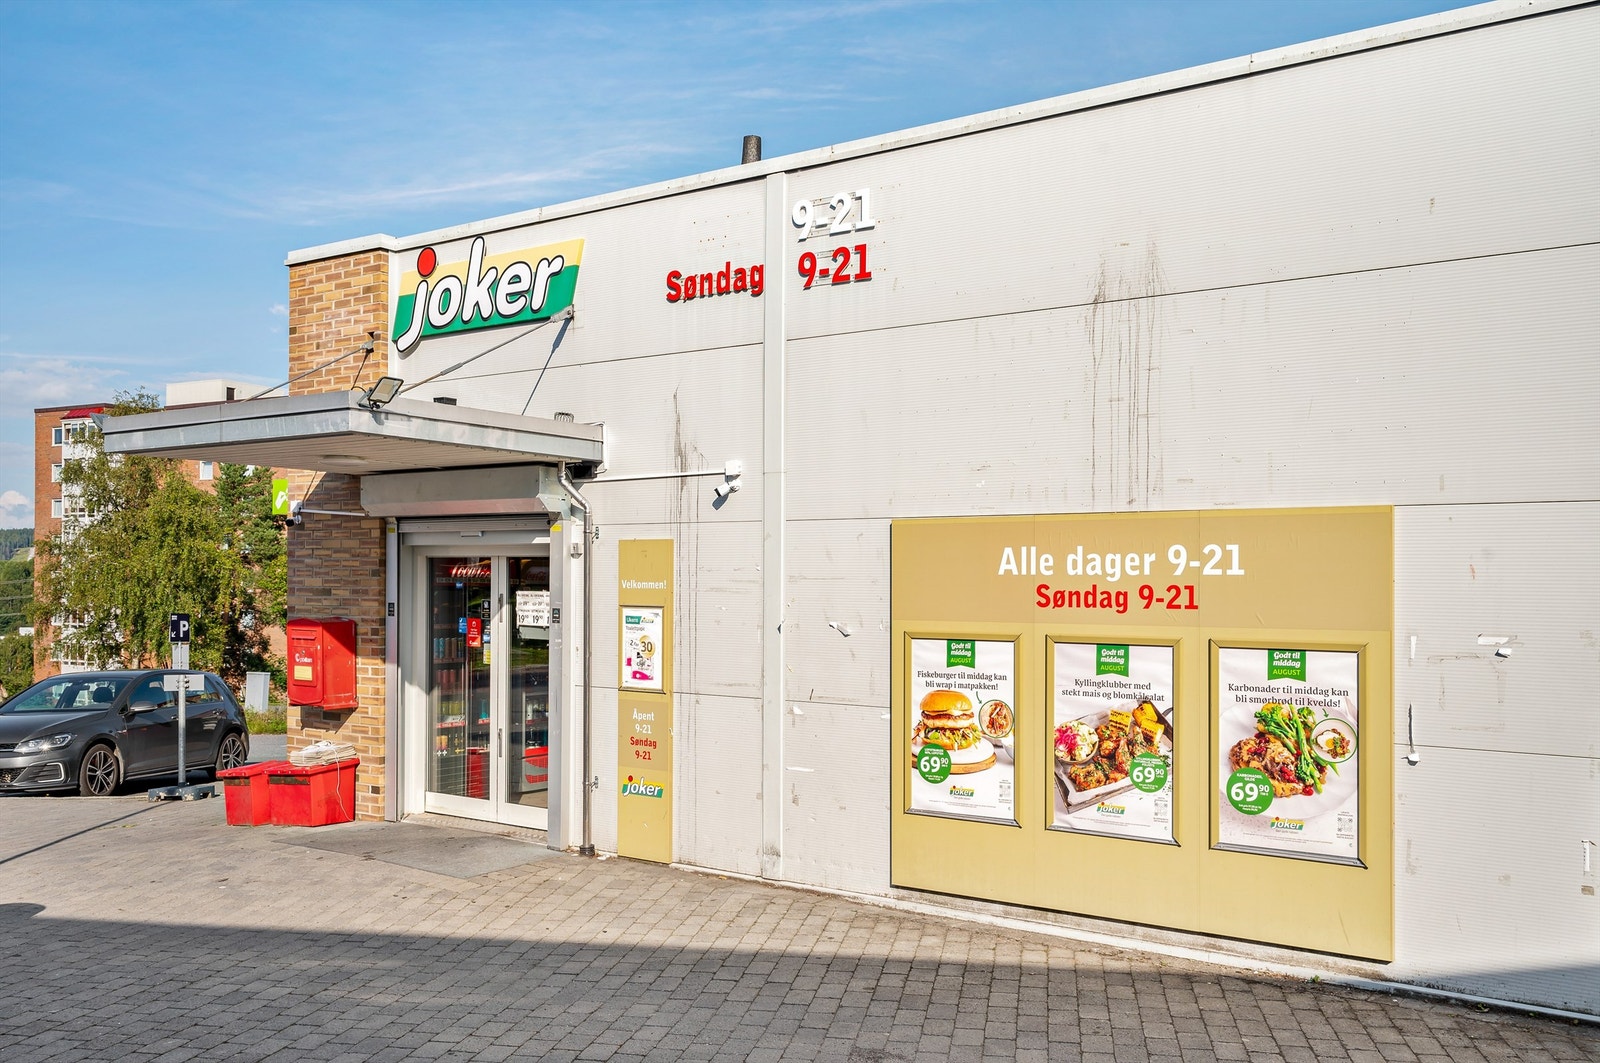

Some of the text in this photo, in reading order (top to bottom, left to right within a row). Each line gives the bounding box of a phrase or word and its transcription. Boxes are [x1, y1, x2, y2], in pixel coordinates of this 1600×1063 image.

[792, 188, 875, 241] 9-21
[666, 244, 872, 301] Søndag 9-21
[396, 236, 564, 352] joker
[998, 544, 1245, 582] Alle dager 9-21
[622, 579, 667, 589] Velkommen!
[1036, 583, 1199, 614] Søndag 9-21
[180, 620, 189, 638] P
[641, 641, 653, 652] 30
[951, 642, 965, 650] Godt
[1101, 648, 1116, 657] Godt
[951, 649, 971, 657] middag
[1273, 651, 1292, 660] Godt
[1101, 656, 1124, 664] middag
[1273, 659, 1300, 668] middag
[917, 670, 1007, 681] Fiskeburger til middag kan
[935, 682, 953, 690] wrap
[957, 682, 998, 691] matpakken!
[1074, 678, 1151, 690] Kyllingklubber med
[1228, 683, 1349, 697] Karbonader til middag kan
[1061, 689, 1165, 702] stekt mais og blomkålsalat
[1235, 694, 1341, 708] bli smørbrød til kvelds!
[632, 708, 655, 721] Åpent
[635, 723, 652, 734] 9-21
[630, 736, 657, 749] Søndag
[635, 750, 651, 760] 9-21
[920, 756, 941, 773] 69
[1132, 766, 1155, 783] 69
[623, 775, 661, 796] joker
[950, 785, 973, 797] joker
[1231, 782, 1270, 802] 69 90
[1098, 802, 1123, 814] joker
[1272, 816, 1302, 830] joker
